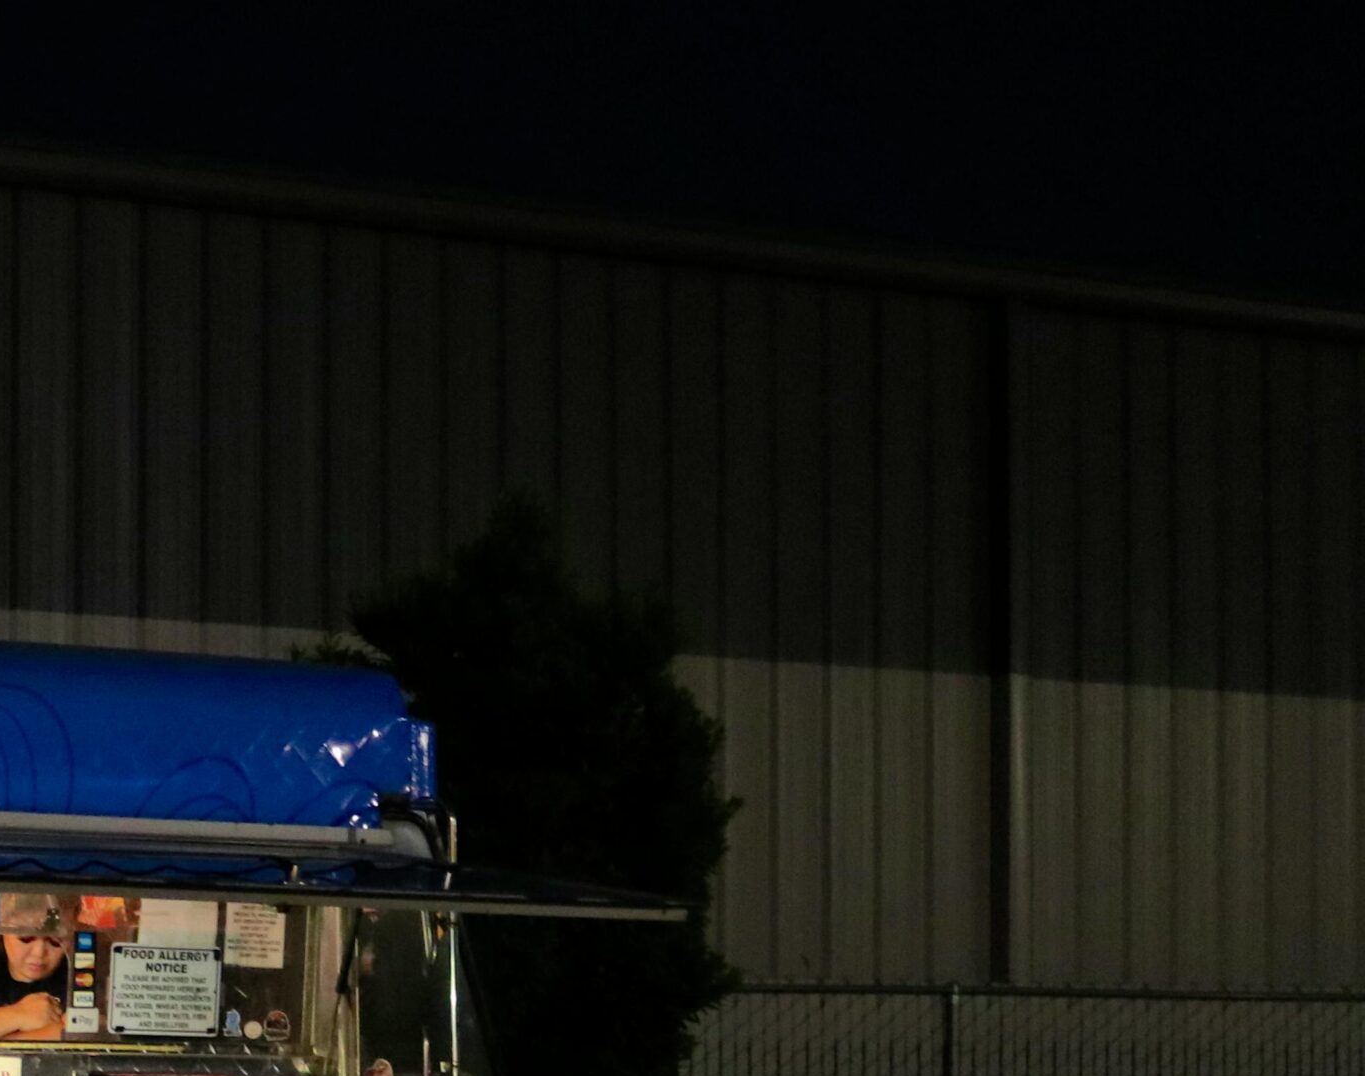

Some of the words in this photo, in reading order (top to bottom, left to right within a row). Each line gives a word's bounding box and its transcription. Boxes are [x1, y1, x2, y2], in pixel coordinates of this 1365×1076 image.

[123, 950, 155, 960] FOOD
[158, 951, 209, 962] ALLERGY
[146, 963, 188, 974] NOTICE
